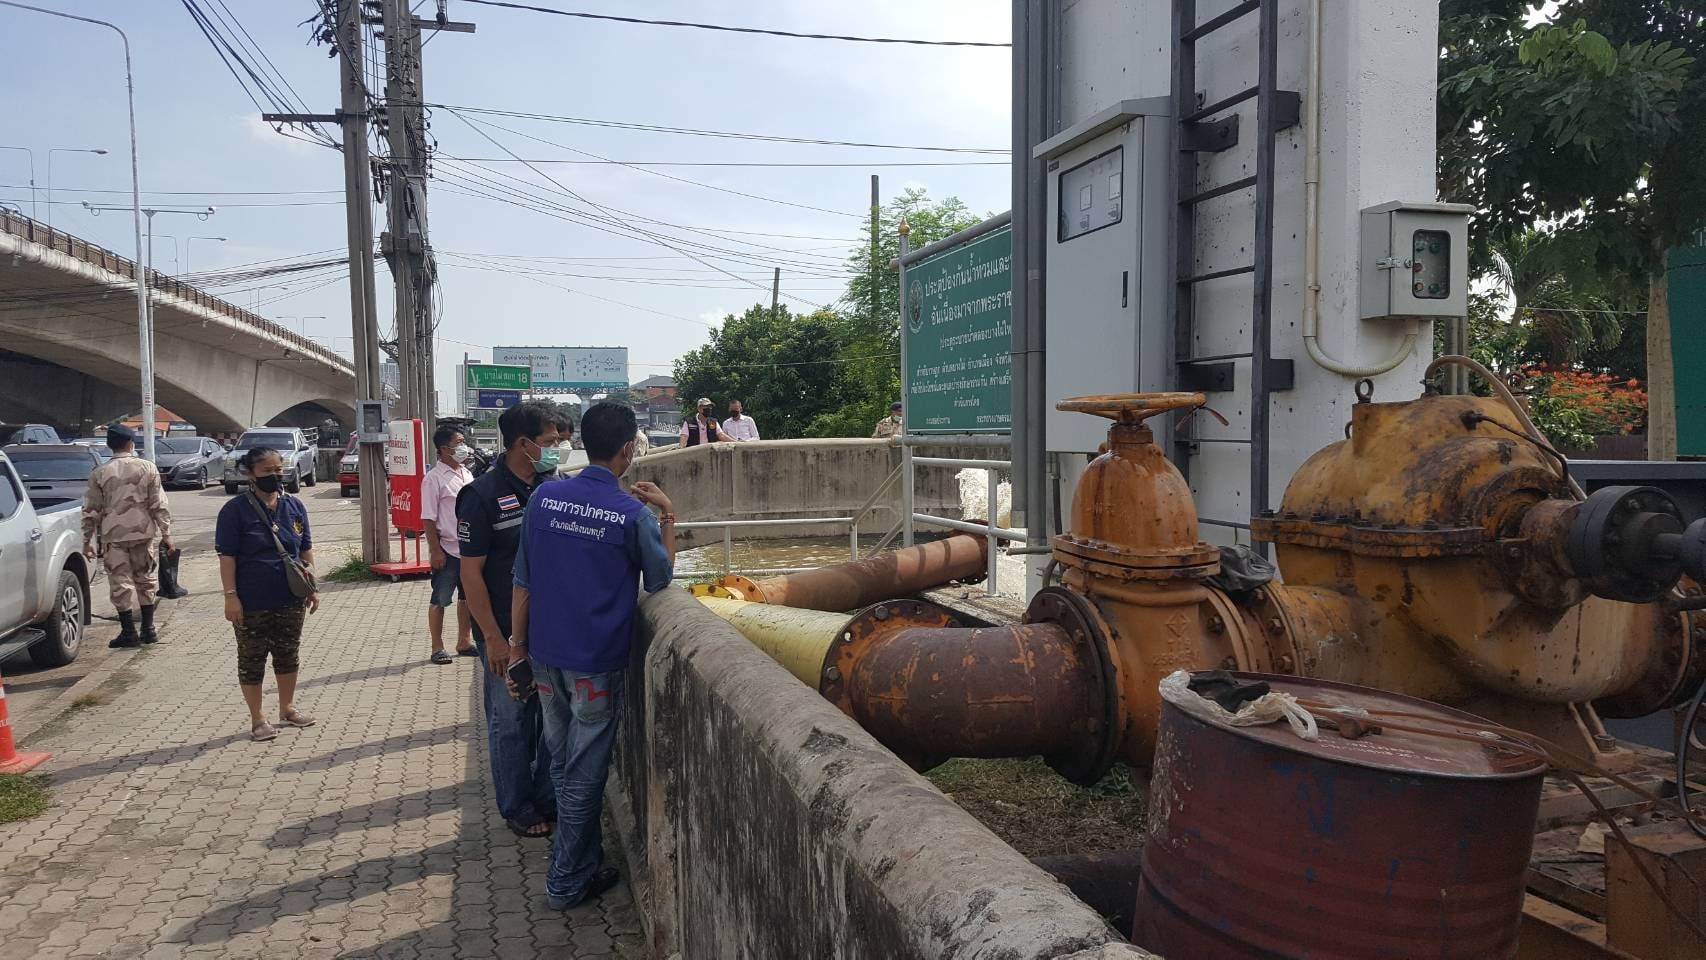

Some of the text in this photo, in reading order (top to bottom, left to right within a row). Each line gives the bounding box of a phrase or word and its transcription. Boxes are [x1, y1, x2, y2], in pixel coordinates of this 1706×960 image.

[925, 252, 1011, 299] ประตูป้องกันน้ำท่วมและ
[518, 373, 528, 383] 18
[540, 497, 626, 525] กรมการปกครอง
